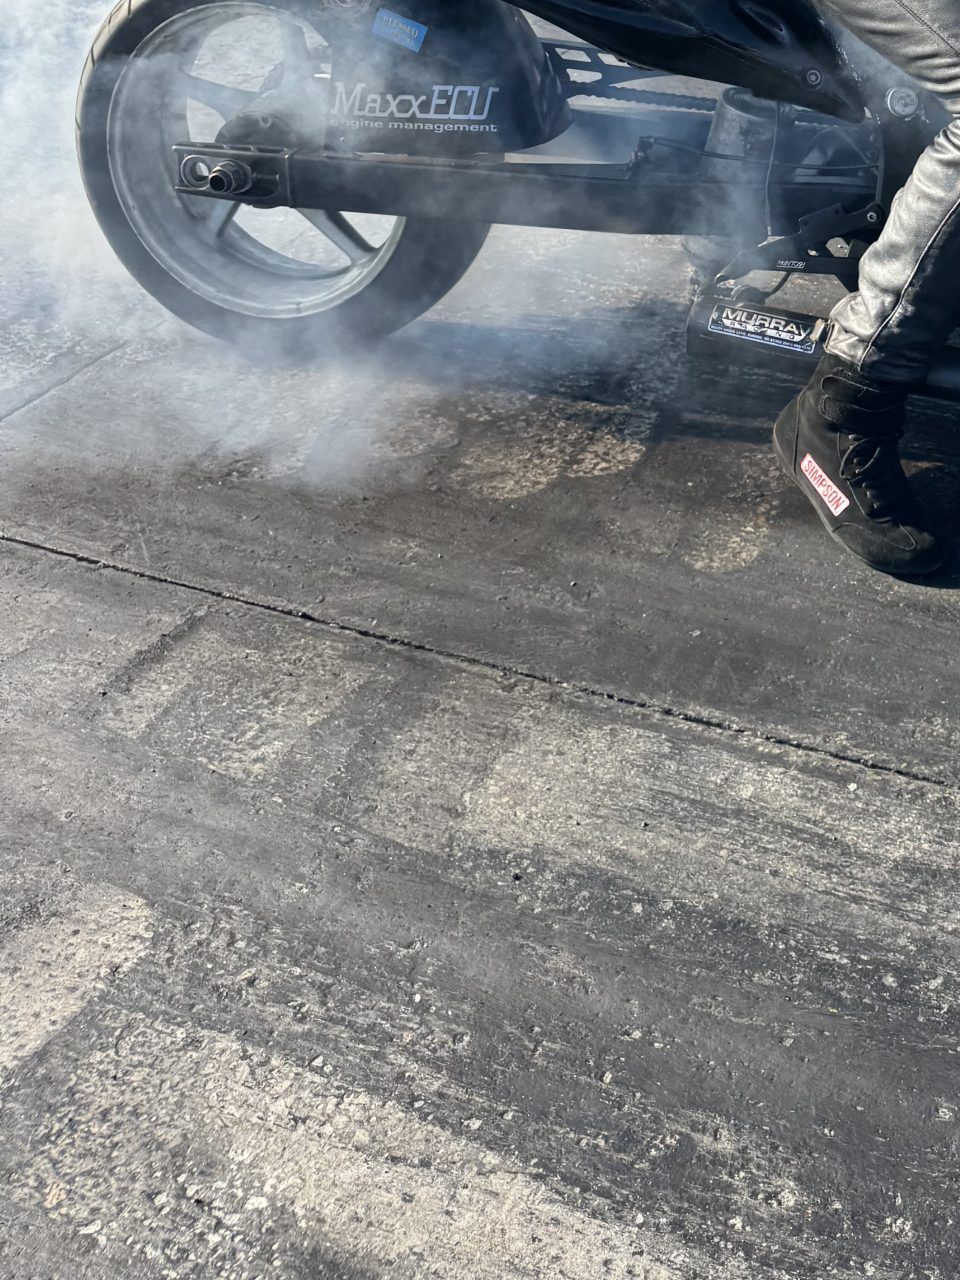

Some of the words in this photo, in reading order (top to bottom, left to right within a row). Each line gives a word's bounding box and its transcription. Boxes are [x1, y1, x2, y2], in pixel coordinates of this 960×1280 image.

[331, 81, 500, 120] MaxxECU
[388, 120, 498, 133] management
[804, 460, 845, 511] SIMPSON
